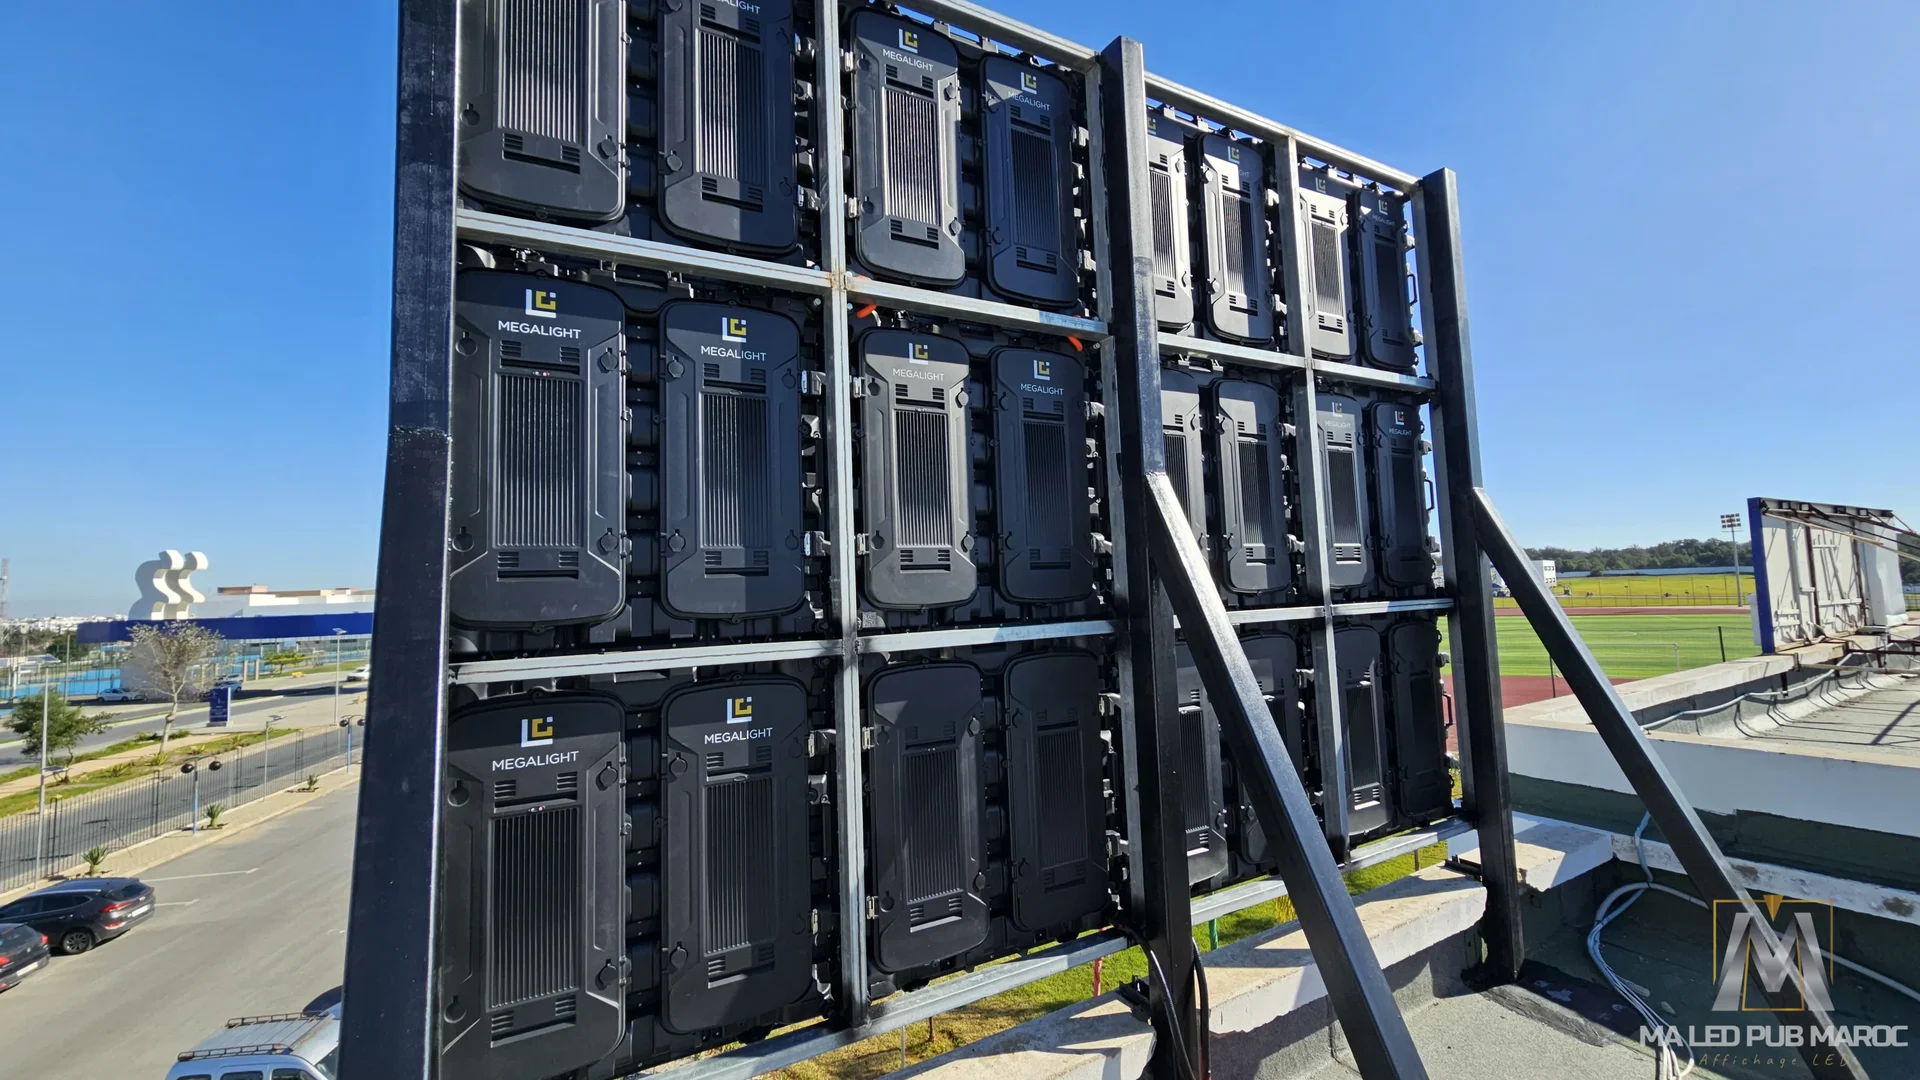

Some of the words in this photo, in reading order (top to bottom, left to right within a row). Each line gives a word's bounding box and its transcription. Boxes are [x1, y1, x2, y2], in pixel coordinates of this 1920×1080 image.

[882, 49, 934, 72] MEGALIGHT
[1007, 92, 1051, 111] MEGALIGHT
[498, 320, 581, 339] MEGALIGHT
[700, 345, 766, 361] MEGALIGHT
[893, 369, 944, 381] MEGALIGHT
[1020, 383, 1064, 396] MEGALIGHT
[704, 727, 773, 745] MEGALIGHT
[491, 751, 580, 772] MEGALIGHT
